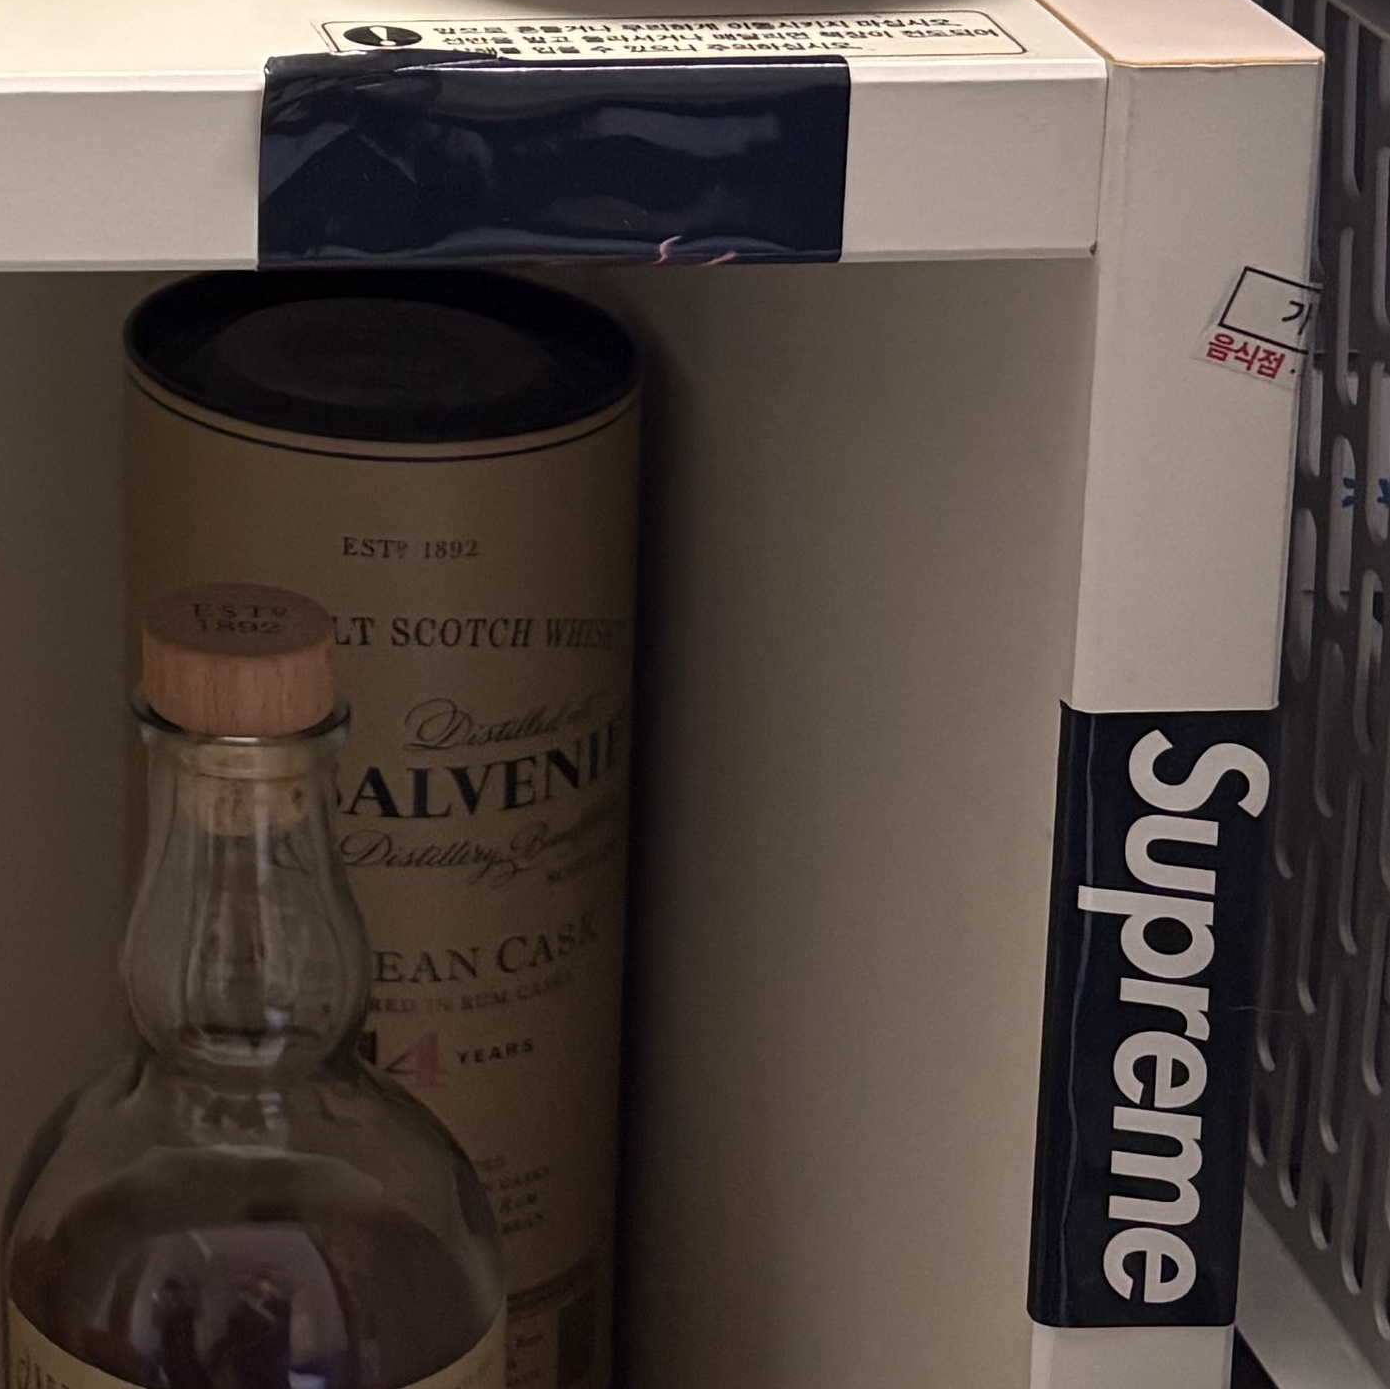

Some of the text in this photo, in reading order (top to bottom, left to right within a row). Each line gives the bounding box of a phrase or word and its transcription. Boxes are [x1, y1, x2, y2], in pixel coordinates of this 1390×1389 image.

[1206, 332, 1286, 379] 음식점
[423, 538, 480, 560] 1892
[390, 616, 534, 648] SCOTCH
[1077, 728, 1271, 1305] Supreme
[456, 1038, 535, 1067] YEARS
